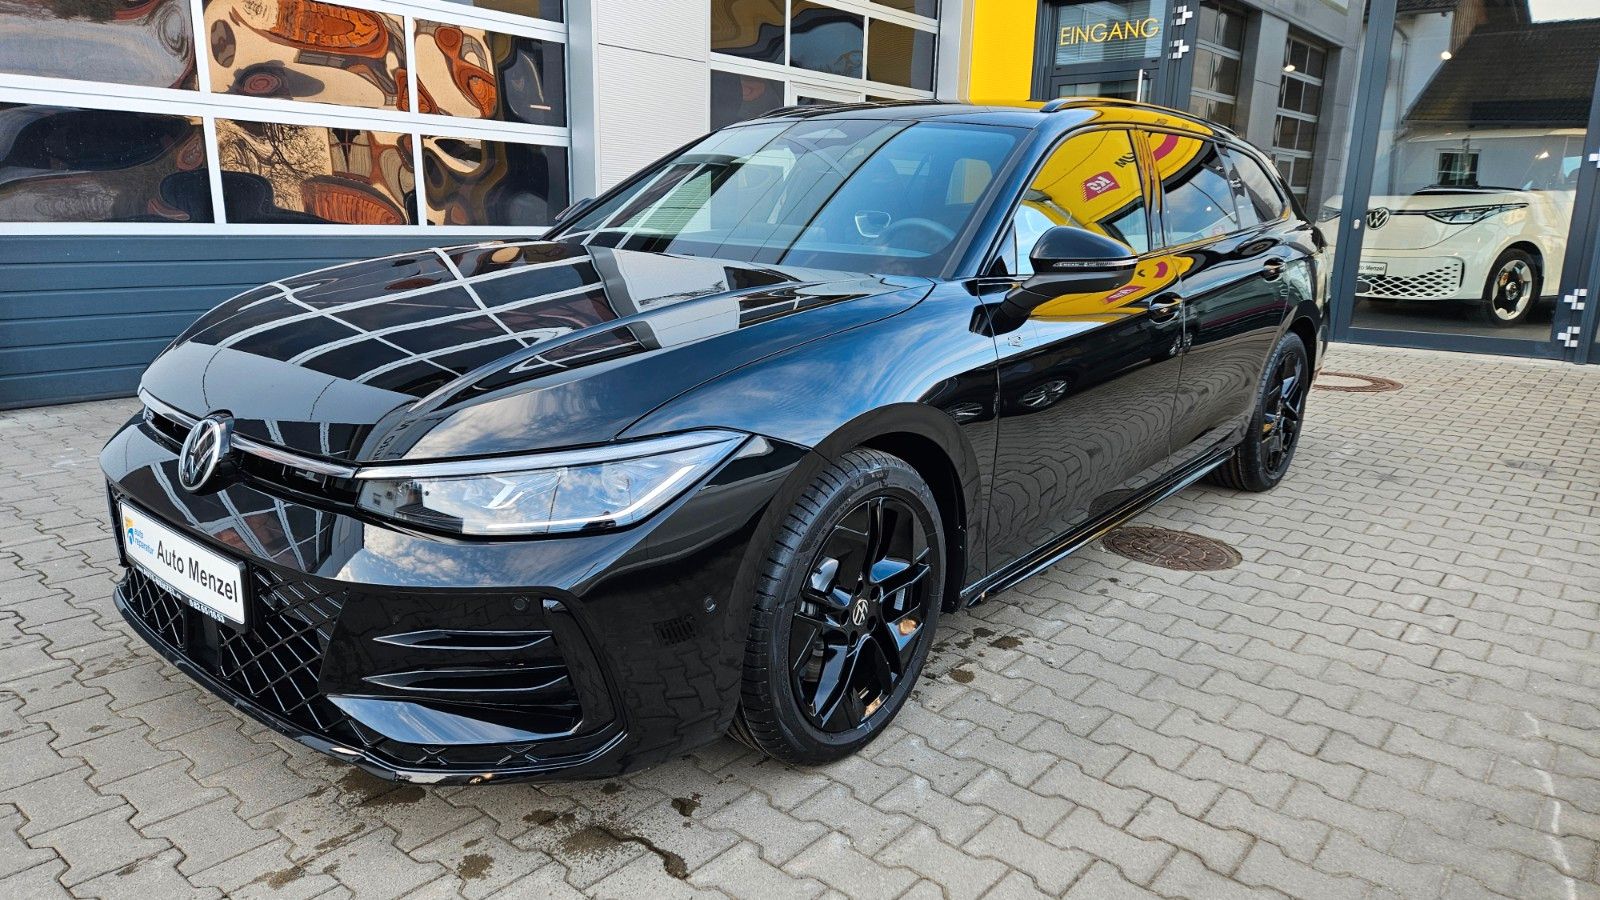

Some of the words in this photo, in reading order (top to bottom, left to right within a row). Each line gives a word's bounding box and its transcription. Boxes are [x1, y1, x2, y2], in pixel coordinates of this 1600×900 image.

[1060, 18, 1159, 45] EINGANG
[157, 540, 185, 574] Auto
[188, 557, 238, 602] Menzel
